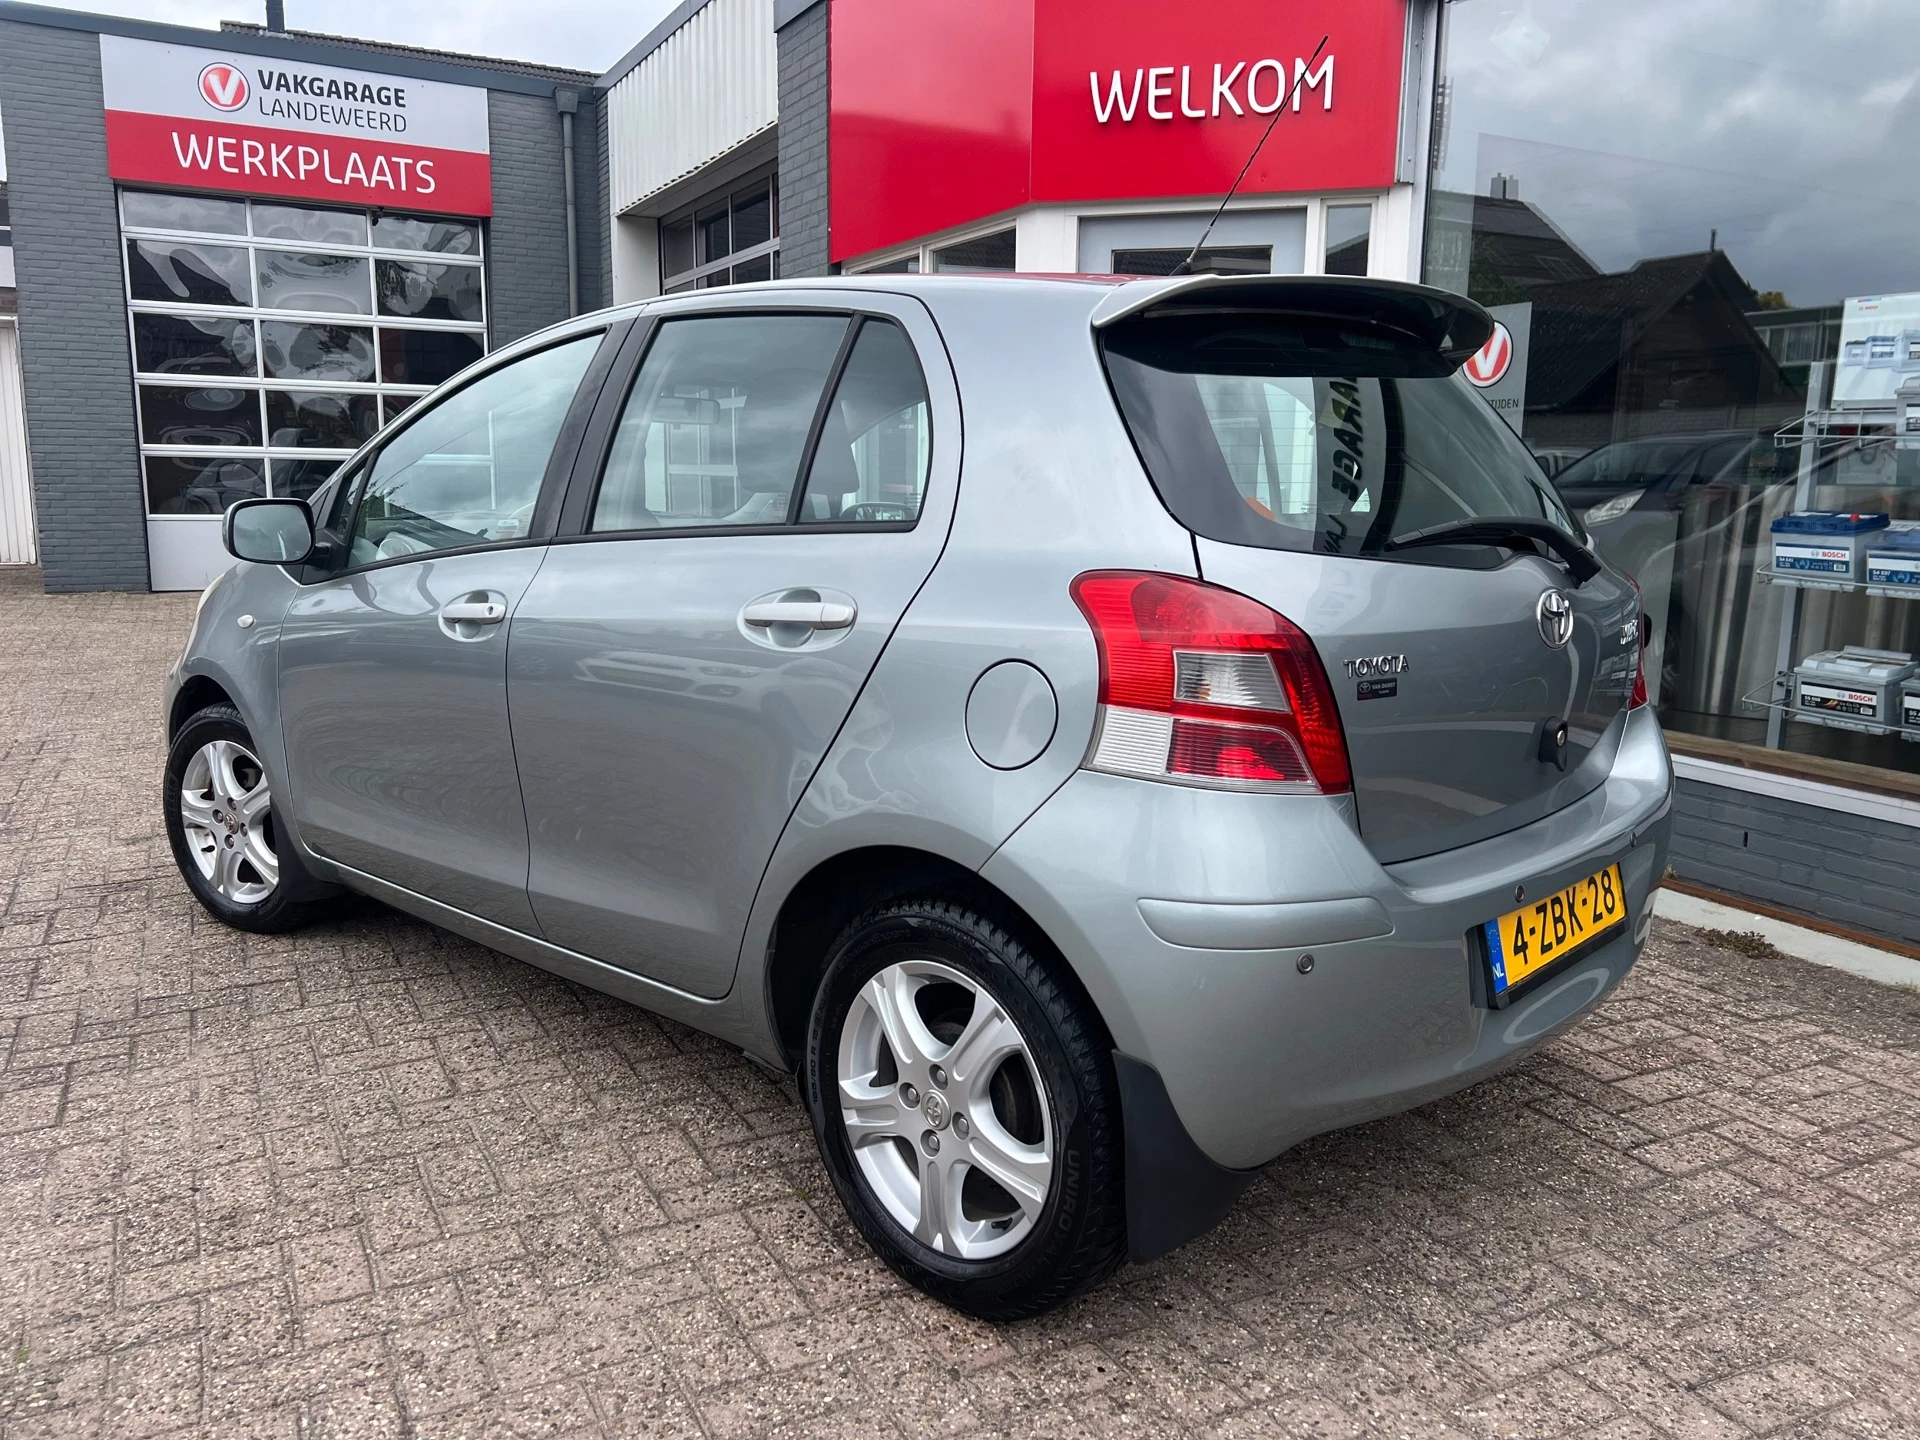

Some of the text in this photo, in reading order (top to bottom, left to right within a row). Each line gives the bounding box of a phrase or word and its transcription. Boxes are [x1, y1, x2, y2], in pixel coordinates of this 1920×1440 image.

[257, 68, 407, 109] VAKGARAGE
[1089, 54, 1335, 124] WELKOM
[258, 96, 407, 133] LANDEWEERD
[171, 130, 437, 194] WERKPLAATS
[1488, 398, 1519, 410] TIJDEN
[1821, 551, 1846, 559] BOSCH
[1343, 653, 1410, 679] TOYOTA
[1848, 693, 1873, 702] BOSCH
[1512, 869, 1616, 966] 4-ZBK-28
[1492, 961, 1505, 981] NL
